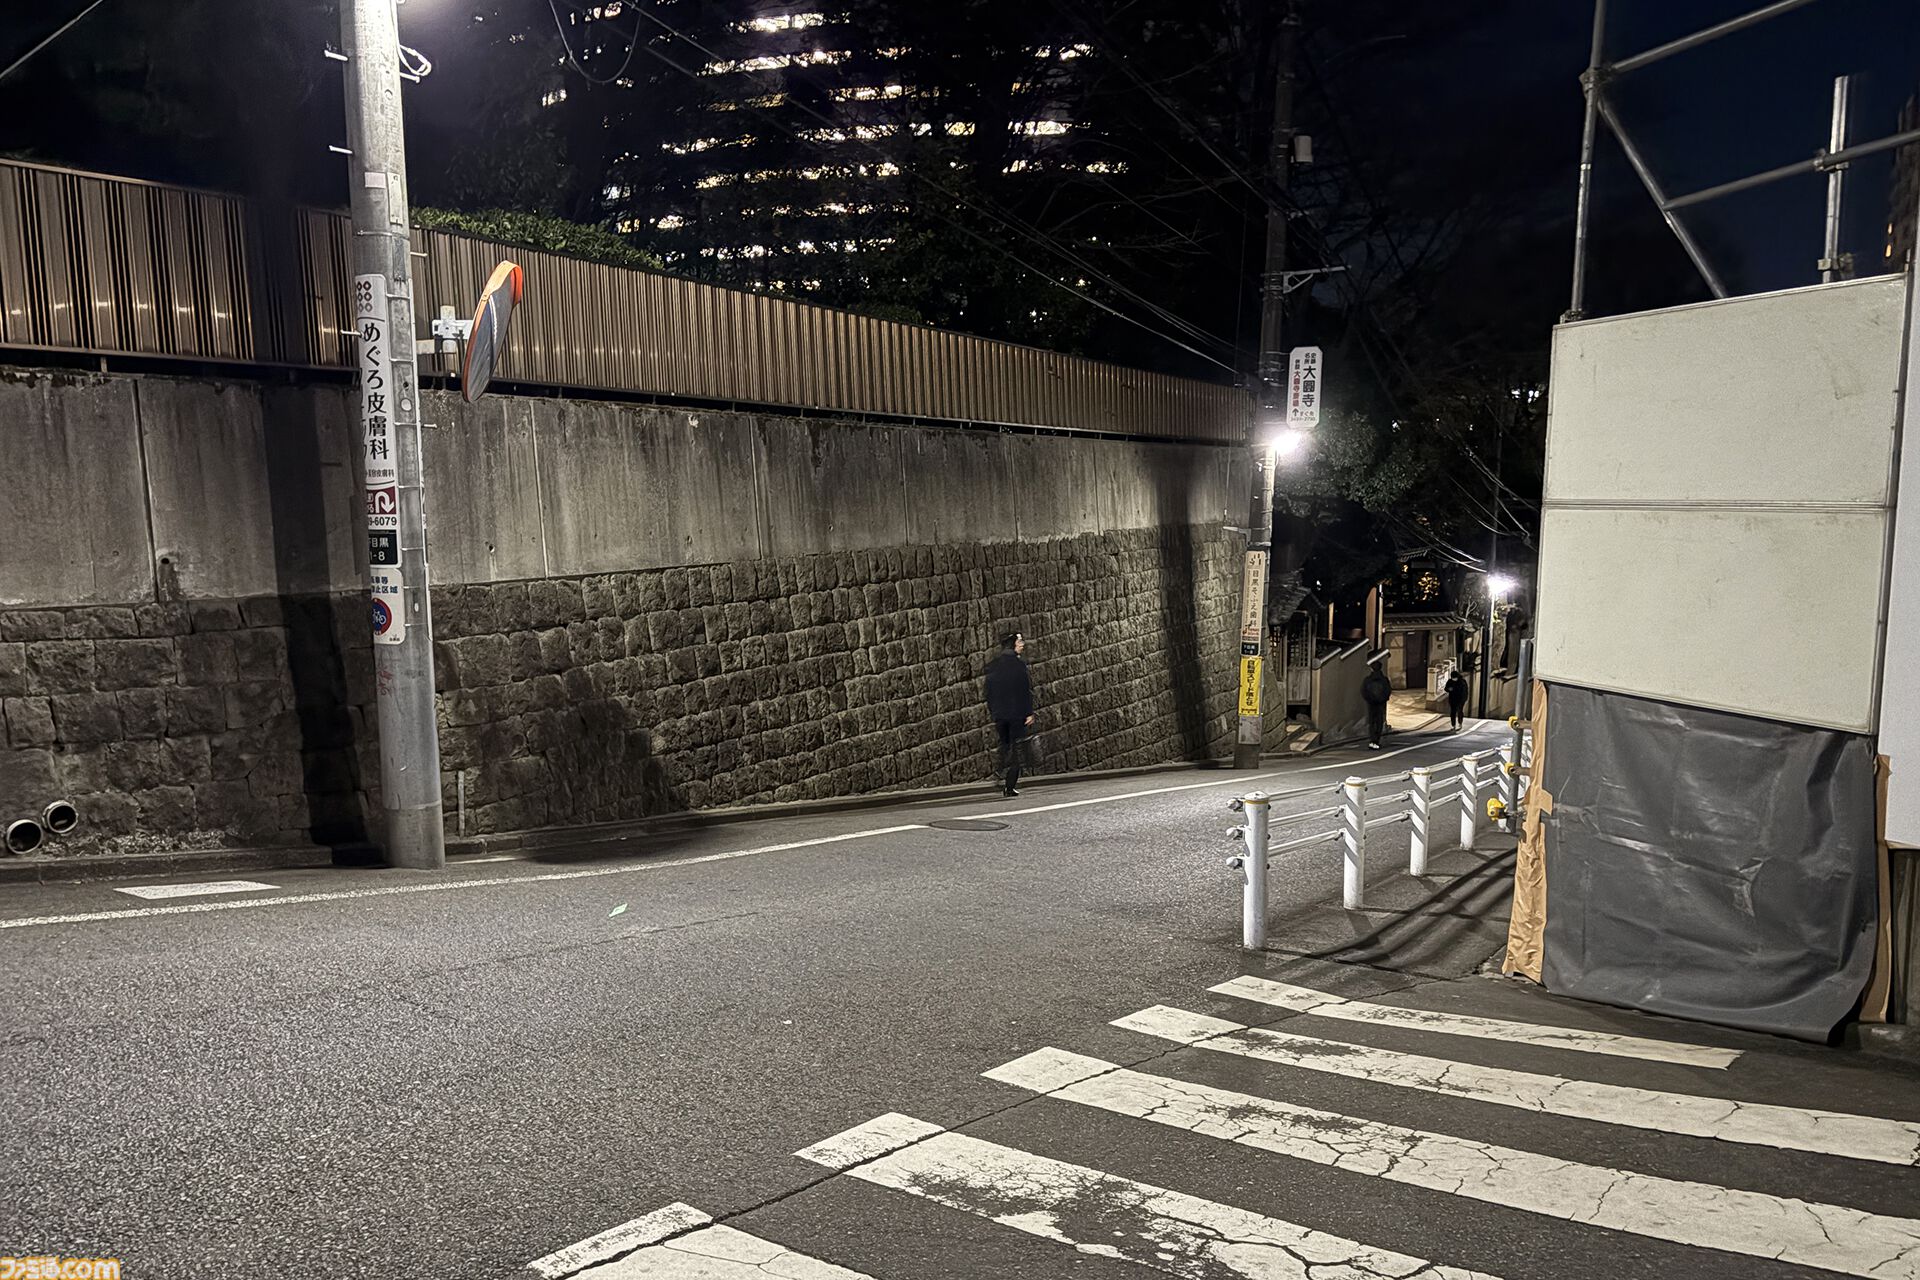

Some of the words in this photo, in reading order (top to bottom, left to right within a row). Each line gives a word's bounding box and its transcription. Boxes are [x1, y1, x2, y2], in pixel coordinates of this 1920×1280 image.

[363, 322, 390, 460] めぐろ皮膚科
[1302, 365, 1317, 407] 大圓寺
